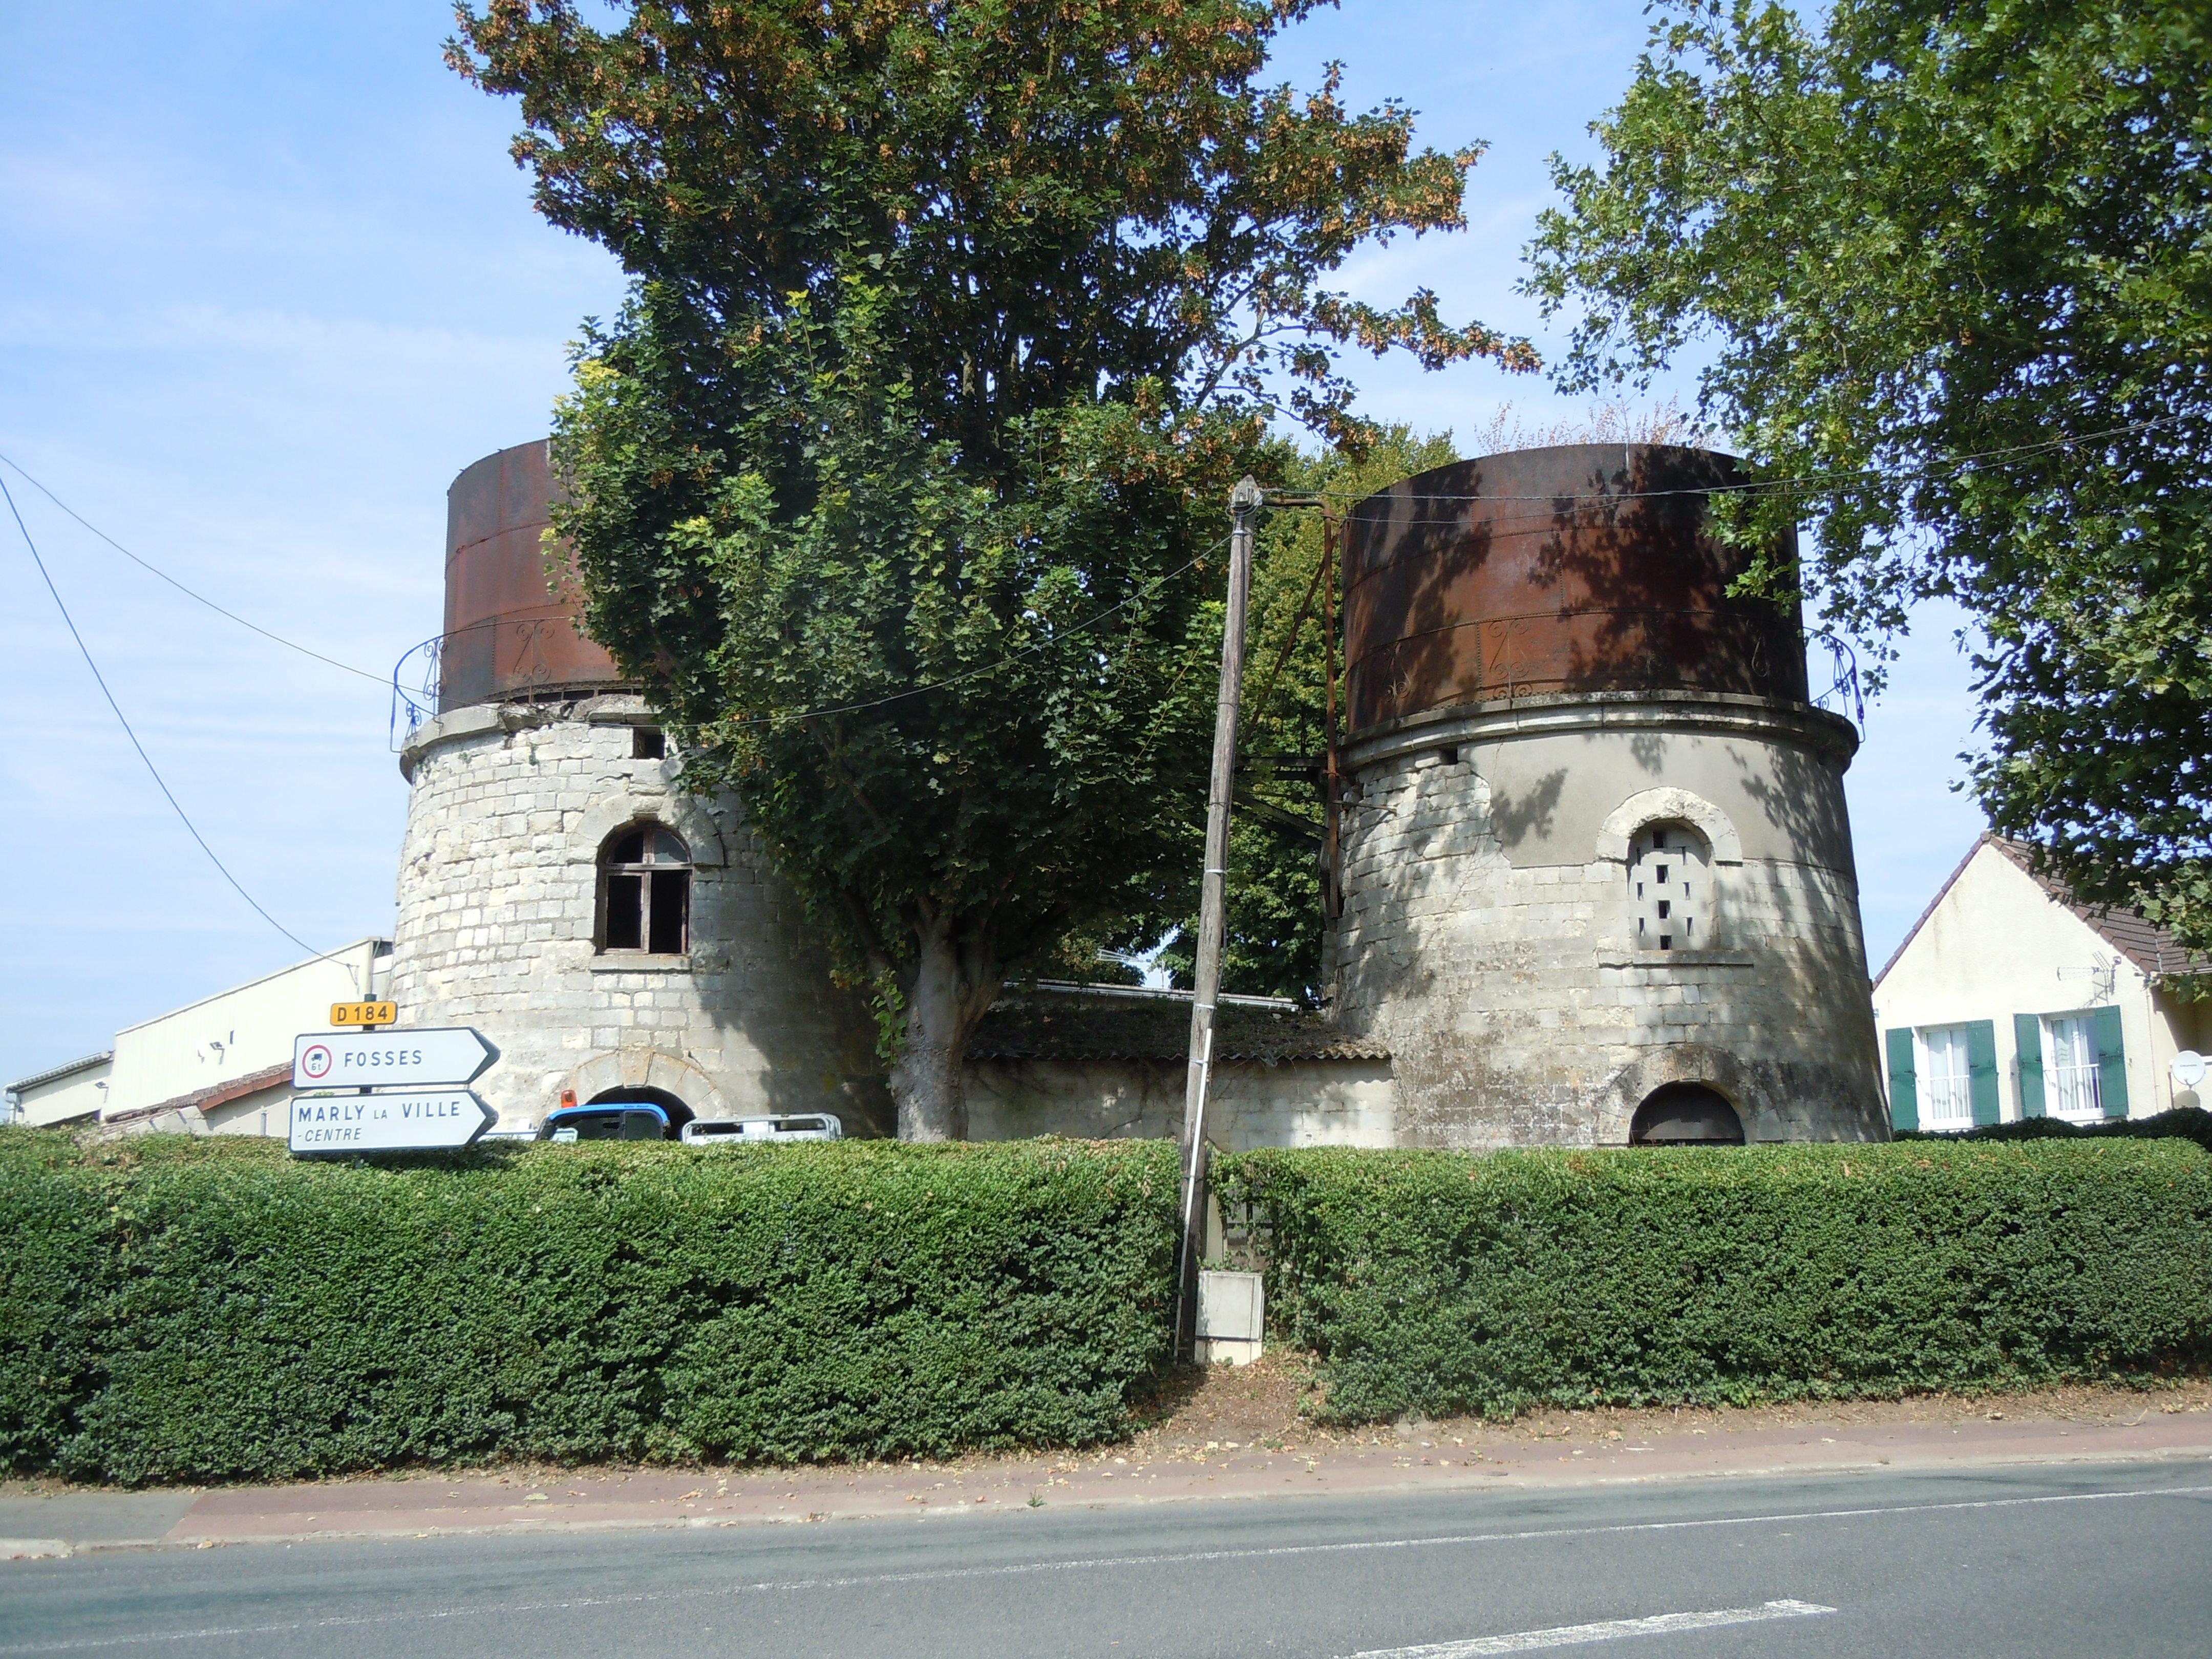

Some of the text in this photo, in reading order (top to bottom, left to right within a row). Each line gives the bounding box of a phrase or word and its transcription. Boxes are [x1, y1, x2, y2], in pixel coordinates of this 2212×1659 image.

[337, 1005, 388, 1022] D 184
[344, 1050, 422, 1067] FOSSES
[298, 1101, 460, 1122] MARLY LA VILLE
